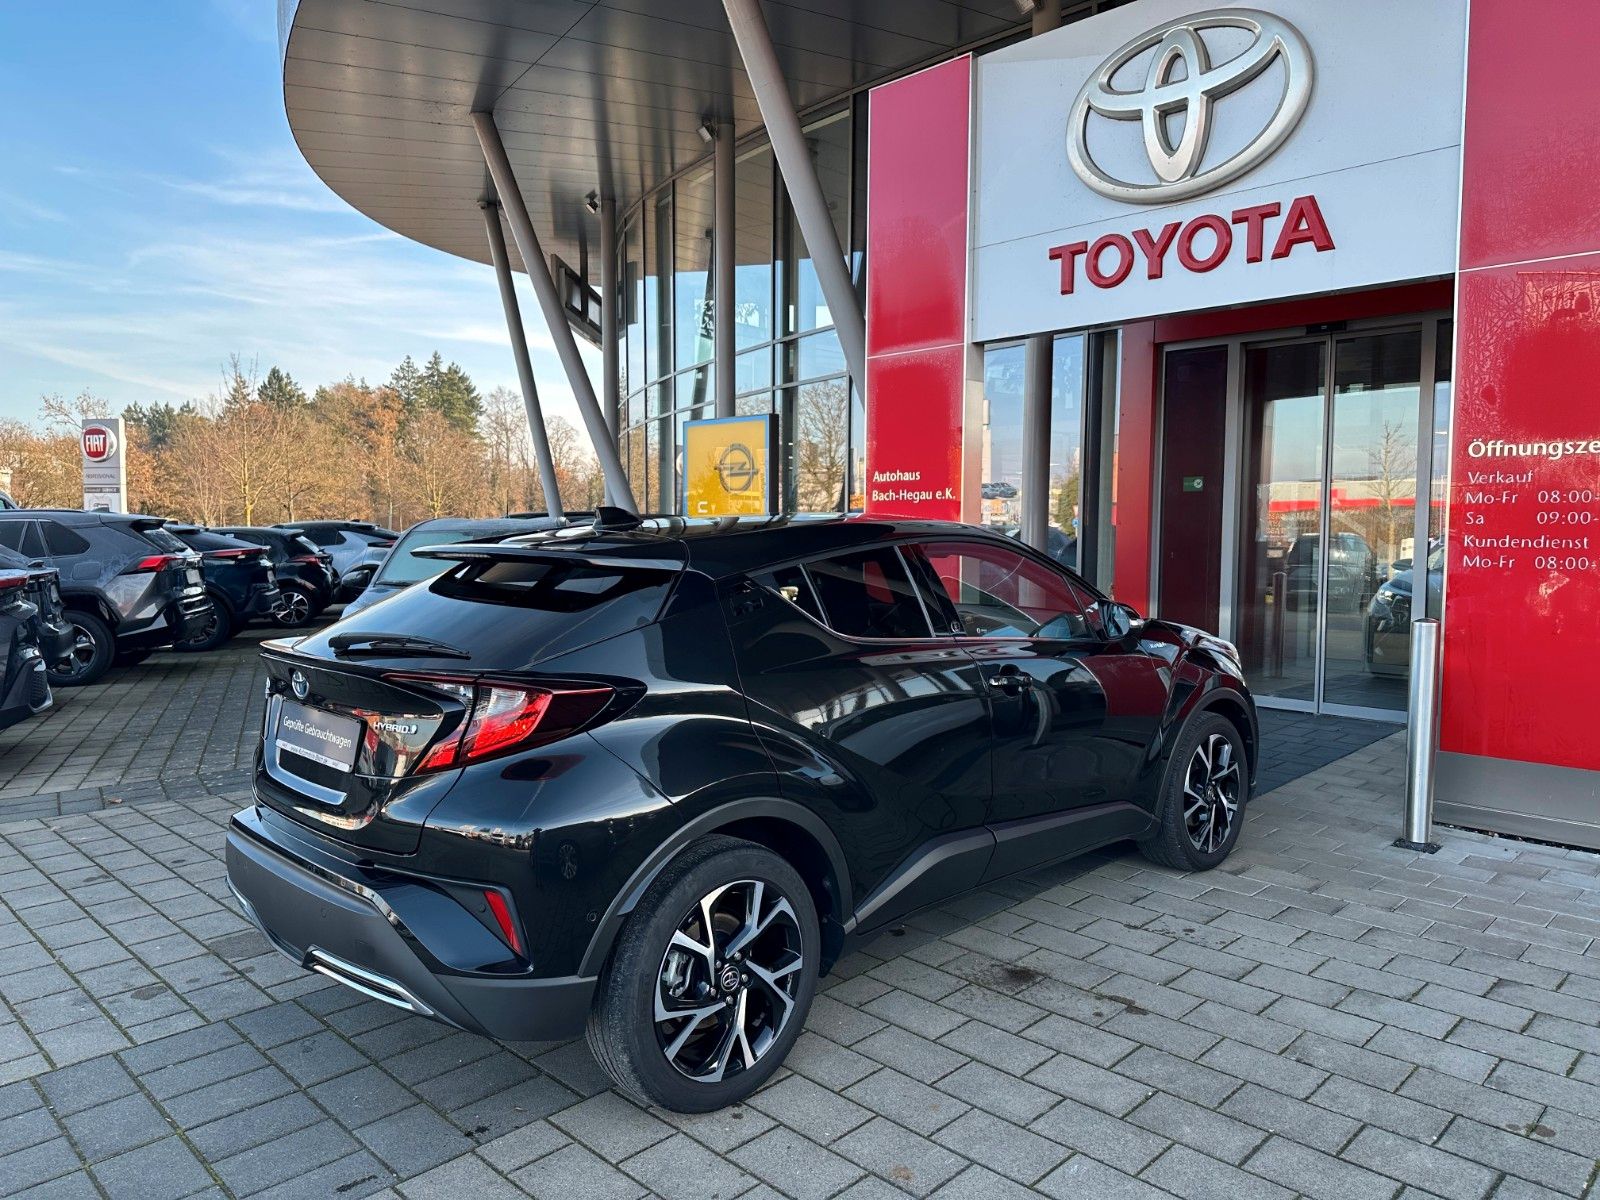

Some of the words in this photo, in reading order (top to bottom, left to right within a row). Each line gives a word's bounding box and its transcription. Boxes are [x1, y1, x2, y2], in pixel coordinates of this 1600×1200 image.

[1049, 195, 1336, 295] TOYOTA
[85, 434, 105, 452] FIAT
[873, 469, 920, 482] Autohaus
[1467, 470, 1534, 484] Verkauf
[872, 489, 933, 503] Bach-Hegau
[935, 488, 956, 500] e.K.
[1465, 490, 1518, 504] Mo-Fr
[1465, 511, 1484, 524] Sa
[1463, 534, 1590, 549] Kundendienst
[1463, 555, 1515, 568] Mo-Fr
[283, 715, 304, 733] Geprüfte
[304, 722, 352, 748] Gebrauchtwagen
[373, 721, 410, 734] HYBRID
